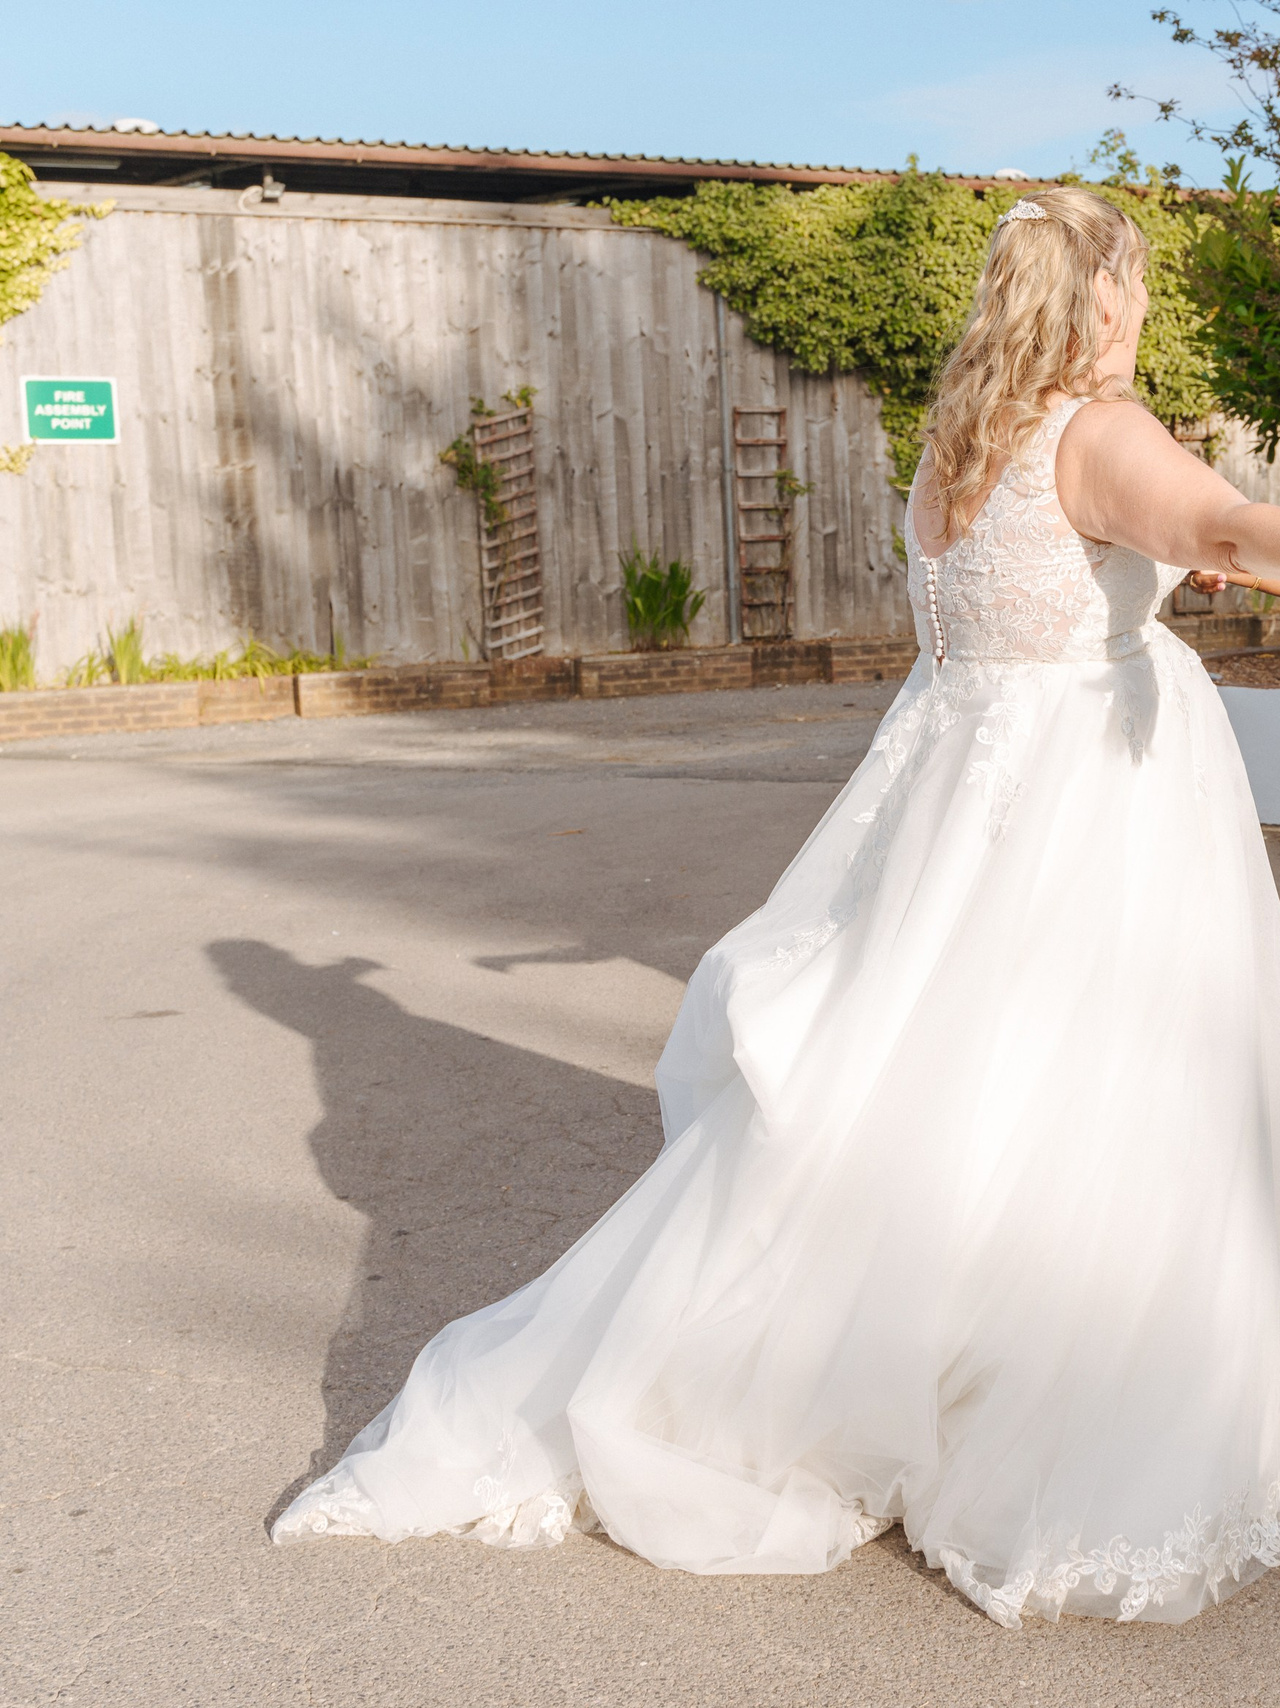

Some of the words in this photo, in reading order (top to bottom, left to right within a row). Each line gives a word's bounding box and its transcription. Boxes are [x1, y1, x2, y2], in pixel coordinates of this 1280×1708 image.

[54, 390, 86, 403] FIRE
[34, 404, 107, 417] ASSEMBLY
[51, 418, 93, 430] POINT
